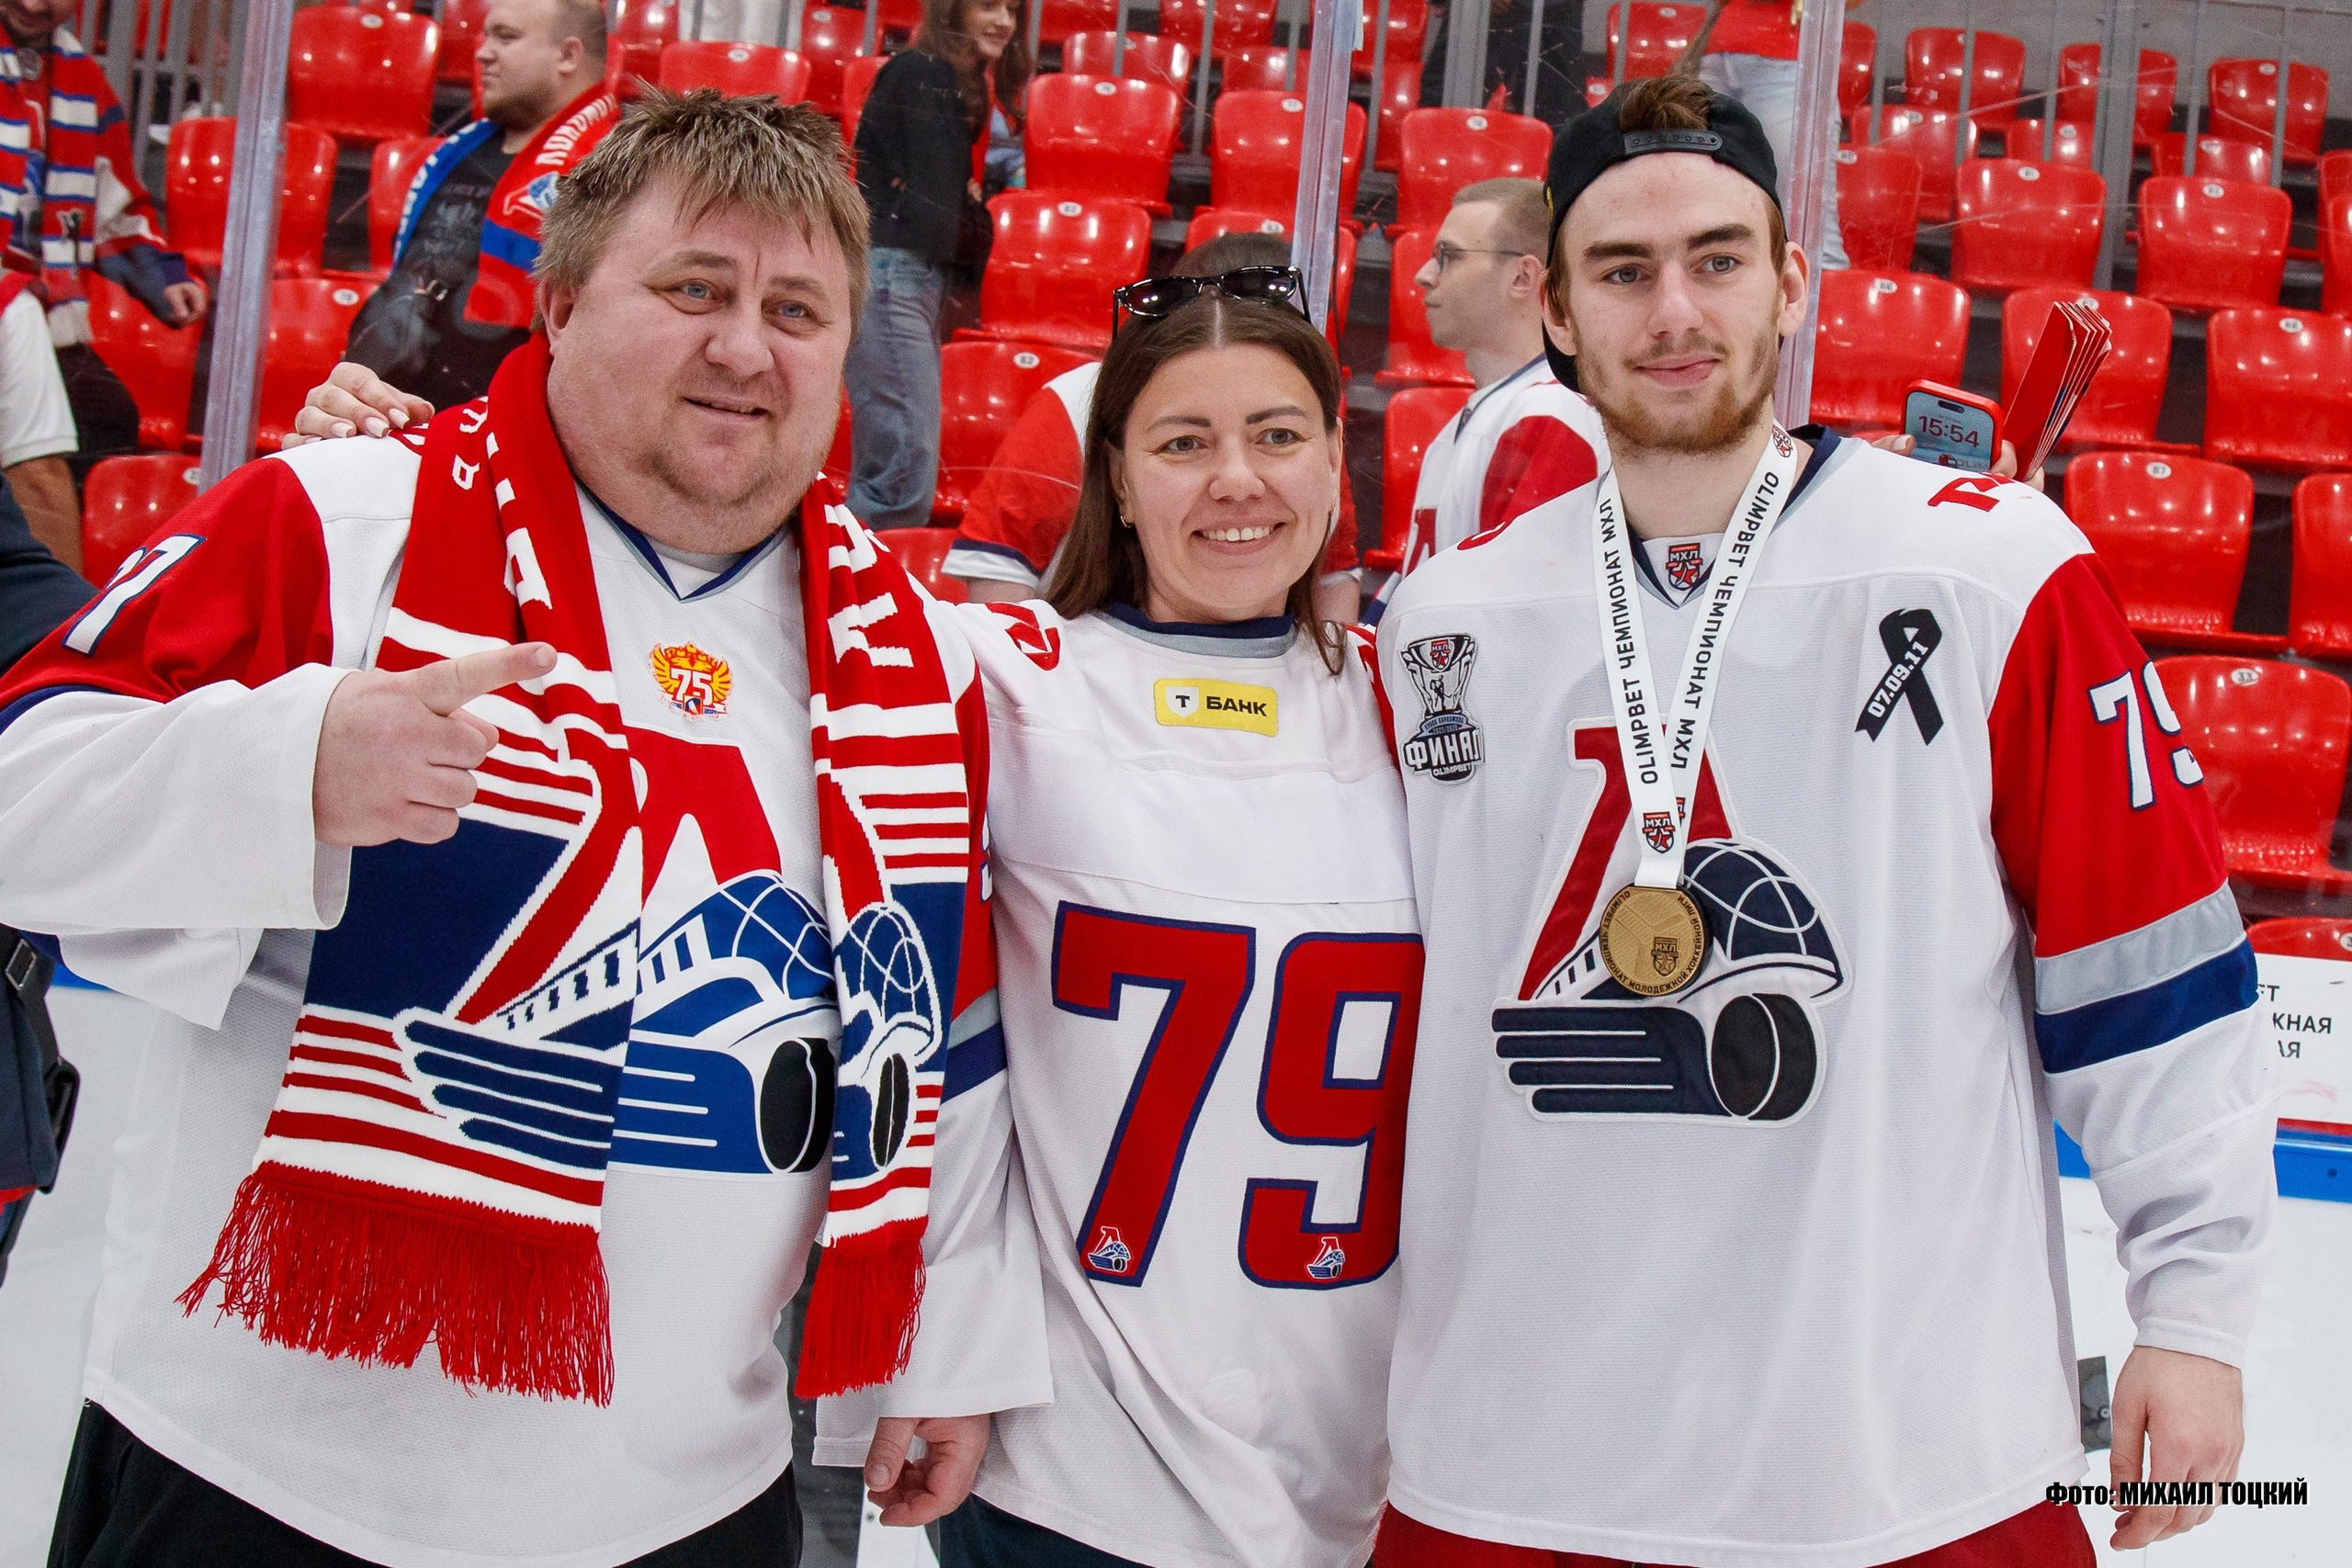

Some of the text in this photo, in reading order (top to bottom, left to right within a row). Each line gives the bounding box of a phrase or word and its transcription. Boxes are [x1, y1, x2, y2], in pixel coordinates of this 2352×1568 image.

[1918, 414, 1980, 448] 15:54
[2153, 466, 2165, 475] 87
[1600, 498, 1617, 544] МХЛ
[1728, 471, 1780, 569] OLIMPBET
[1670, 550, 1699, 562] МХЛ
[1604, 549, 1636, 670] ЧЕМПИОНАТ
[1684, 575, 1738, 709] ЧЕМПИОНАТ
[671, 668, 713, 705] 75
[1868, 641, 1929, 718] 07.09.11
[2238, 671, 2253, 682] 33
[1175, 694, 1268, 717] Т БАНК
[1405, 728, 1481, 770] ФИНАЛ
[1623, 678, 1658, 784] OLIMPBET
[1670, 718, 1696, 769] МХЛ
[1432, 764, 1472, 776] OLIMPBET
[1645, 818, 1670, 828] МХЛ
[1601, 891, 1702, 995] OLIMPBET ЧЕМПИОНАТ МОЛОДЕЖНОЙ ХОККЕЙНОЙ ЛИГИ
[1655, 942, 1677, 953] МХЛ
[2258, 984, 2280, 1002] Т
[1051, 899, 1426, 1292] 79
